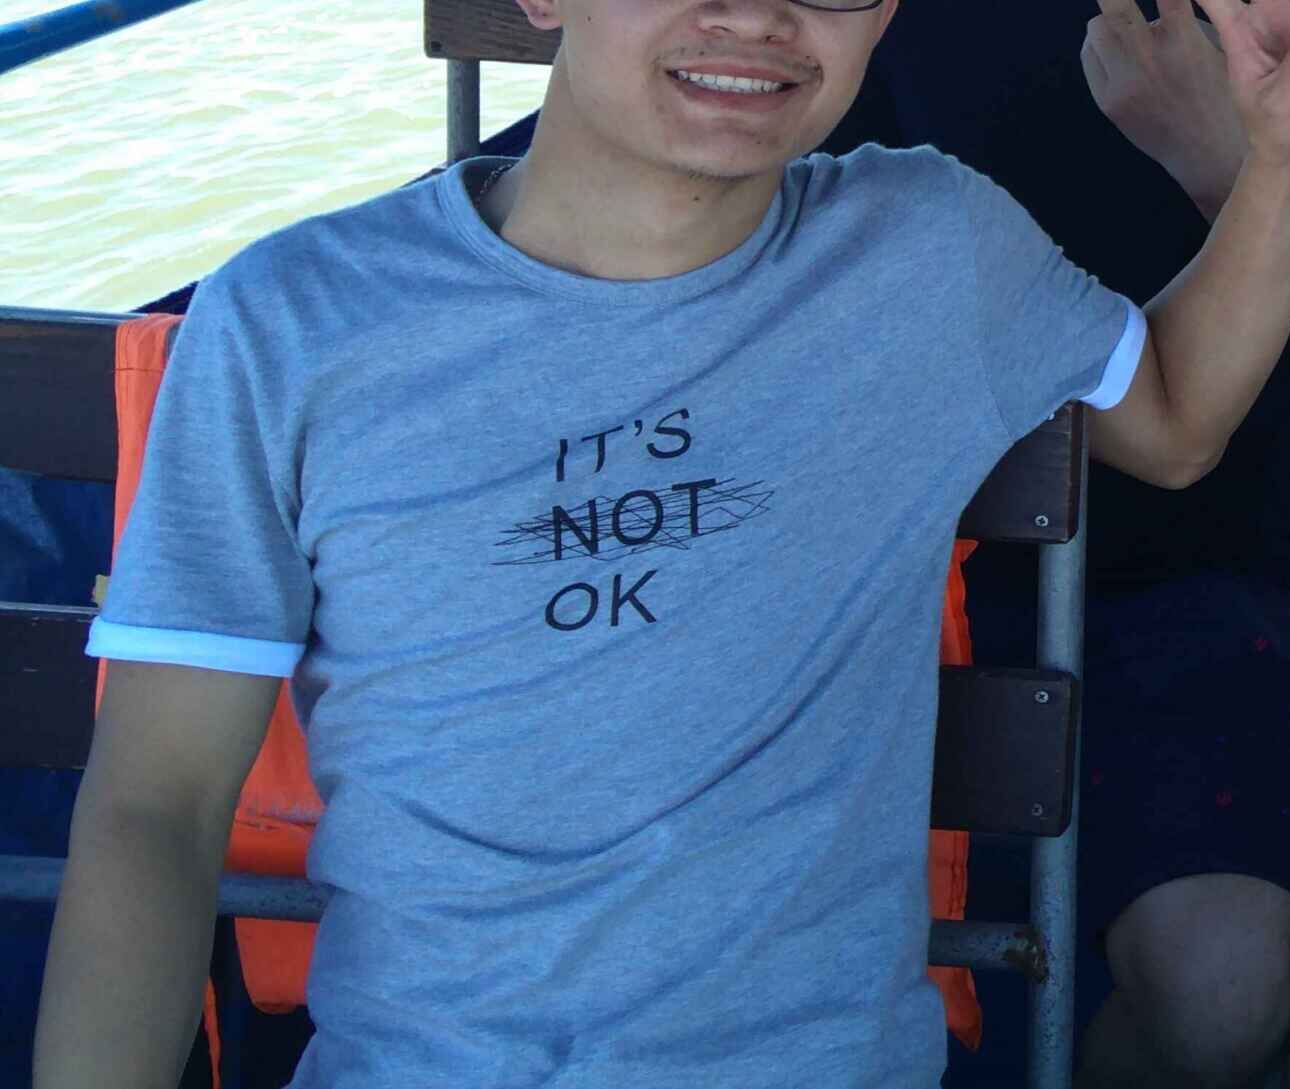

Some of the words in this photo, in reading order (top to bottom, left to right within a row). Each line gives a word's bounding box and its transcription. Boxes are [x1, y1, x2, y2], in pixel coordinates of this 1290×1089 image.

[556, 408, 692, 482] IT'S
[552, 478, 717, 560] NOT
[545, 569, 659, 631] OK
